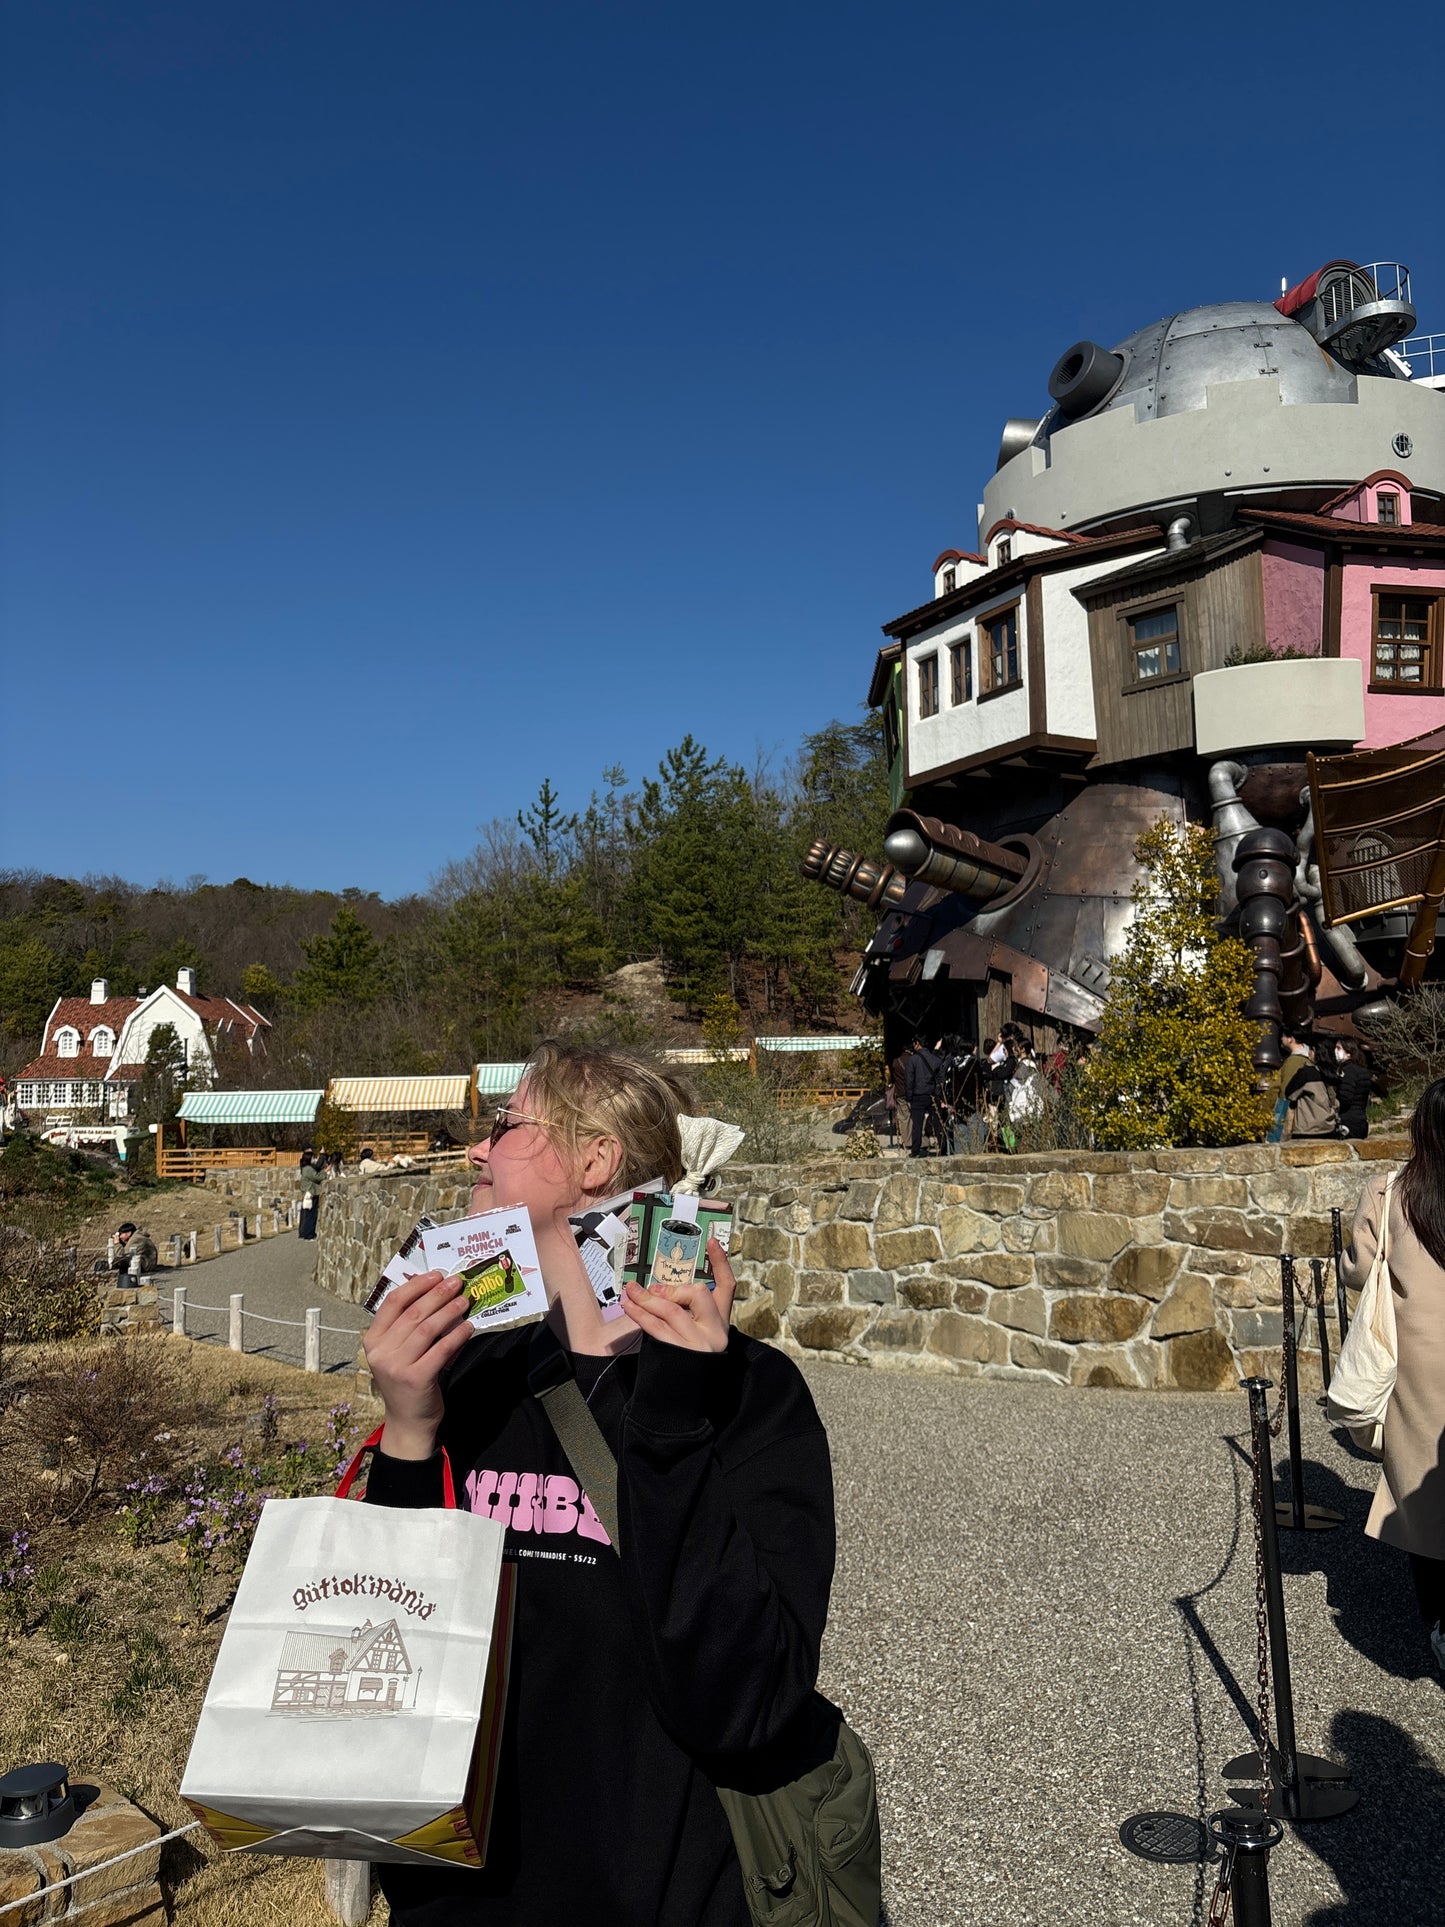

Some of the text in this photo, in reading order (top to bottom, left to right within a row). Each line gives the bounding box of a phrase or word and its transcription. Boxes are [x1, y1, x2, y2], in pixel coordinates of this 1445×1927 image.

[467, 1231, 490, 1245] MIN
[457, 1237, 504, 1257] BRUNCH
[660, 1260, 672, 1269] The
[540, 1551, 567, 1561] PARADISE
[573, 1554, 597, 1565] SS/22
